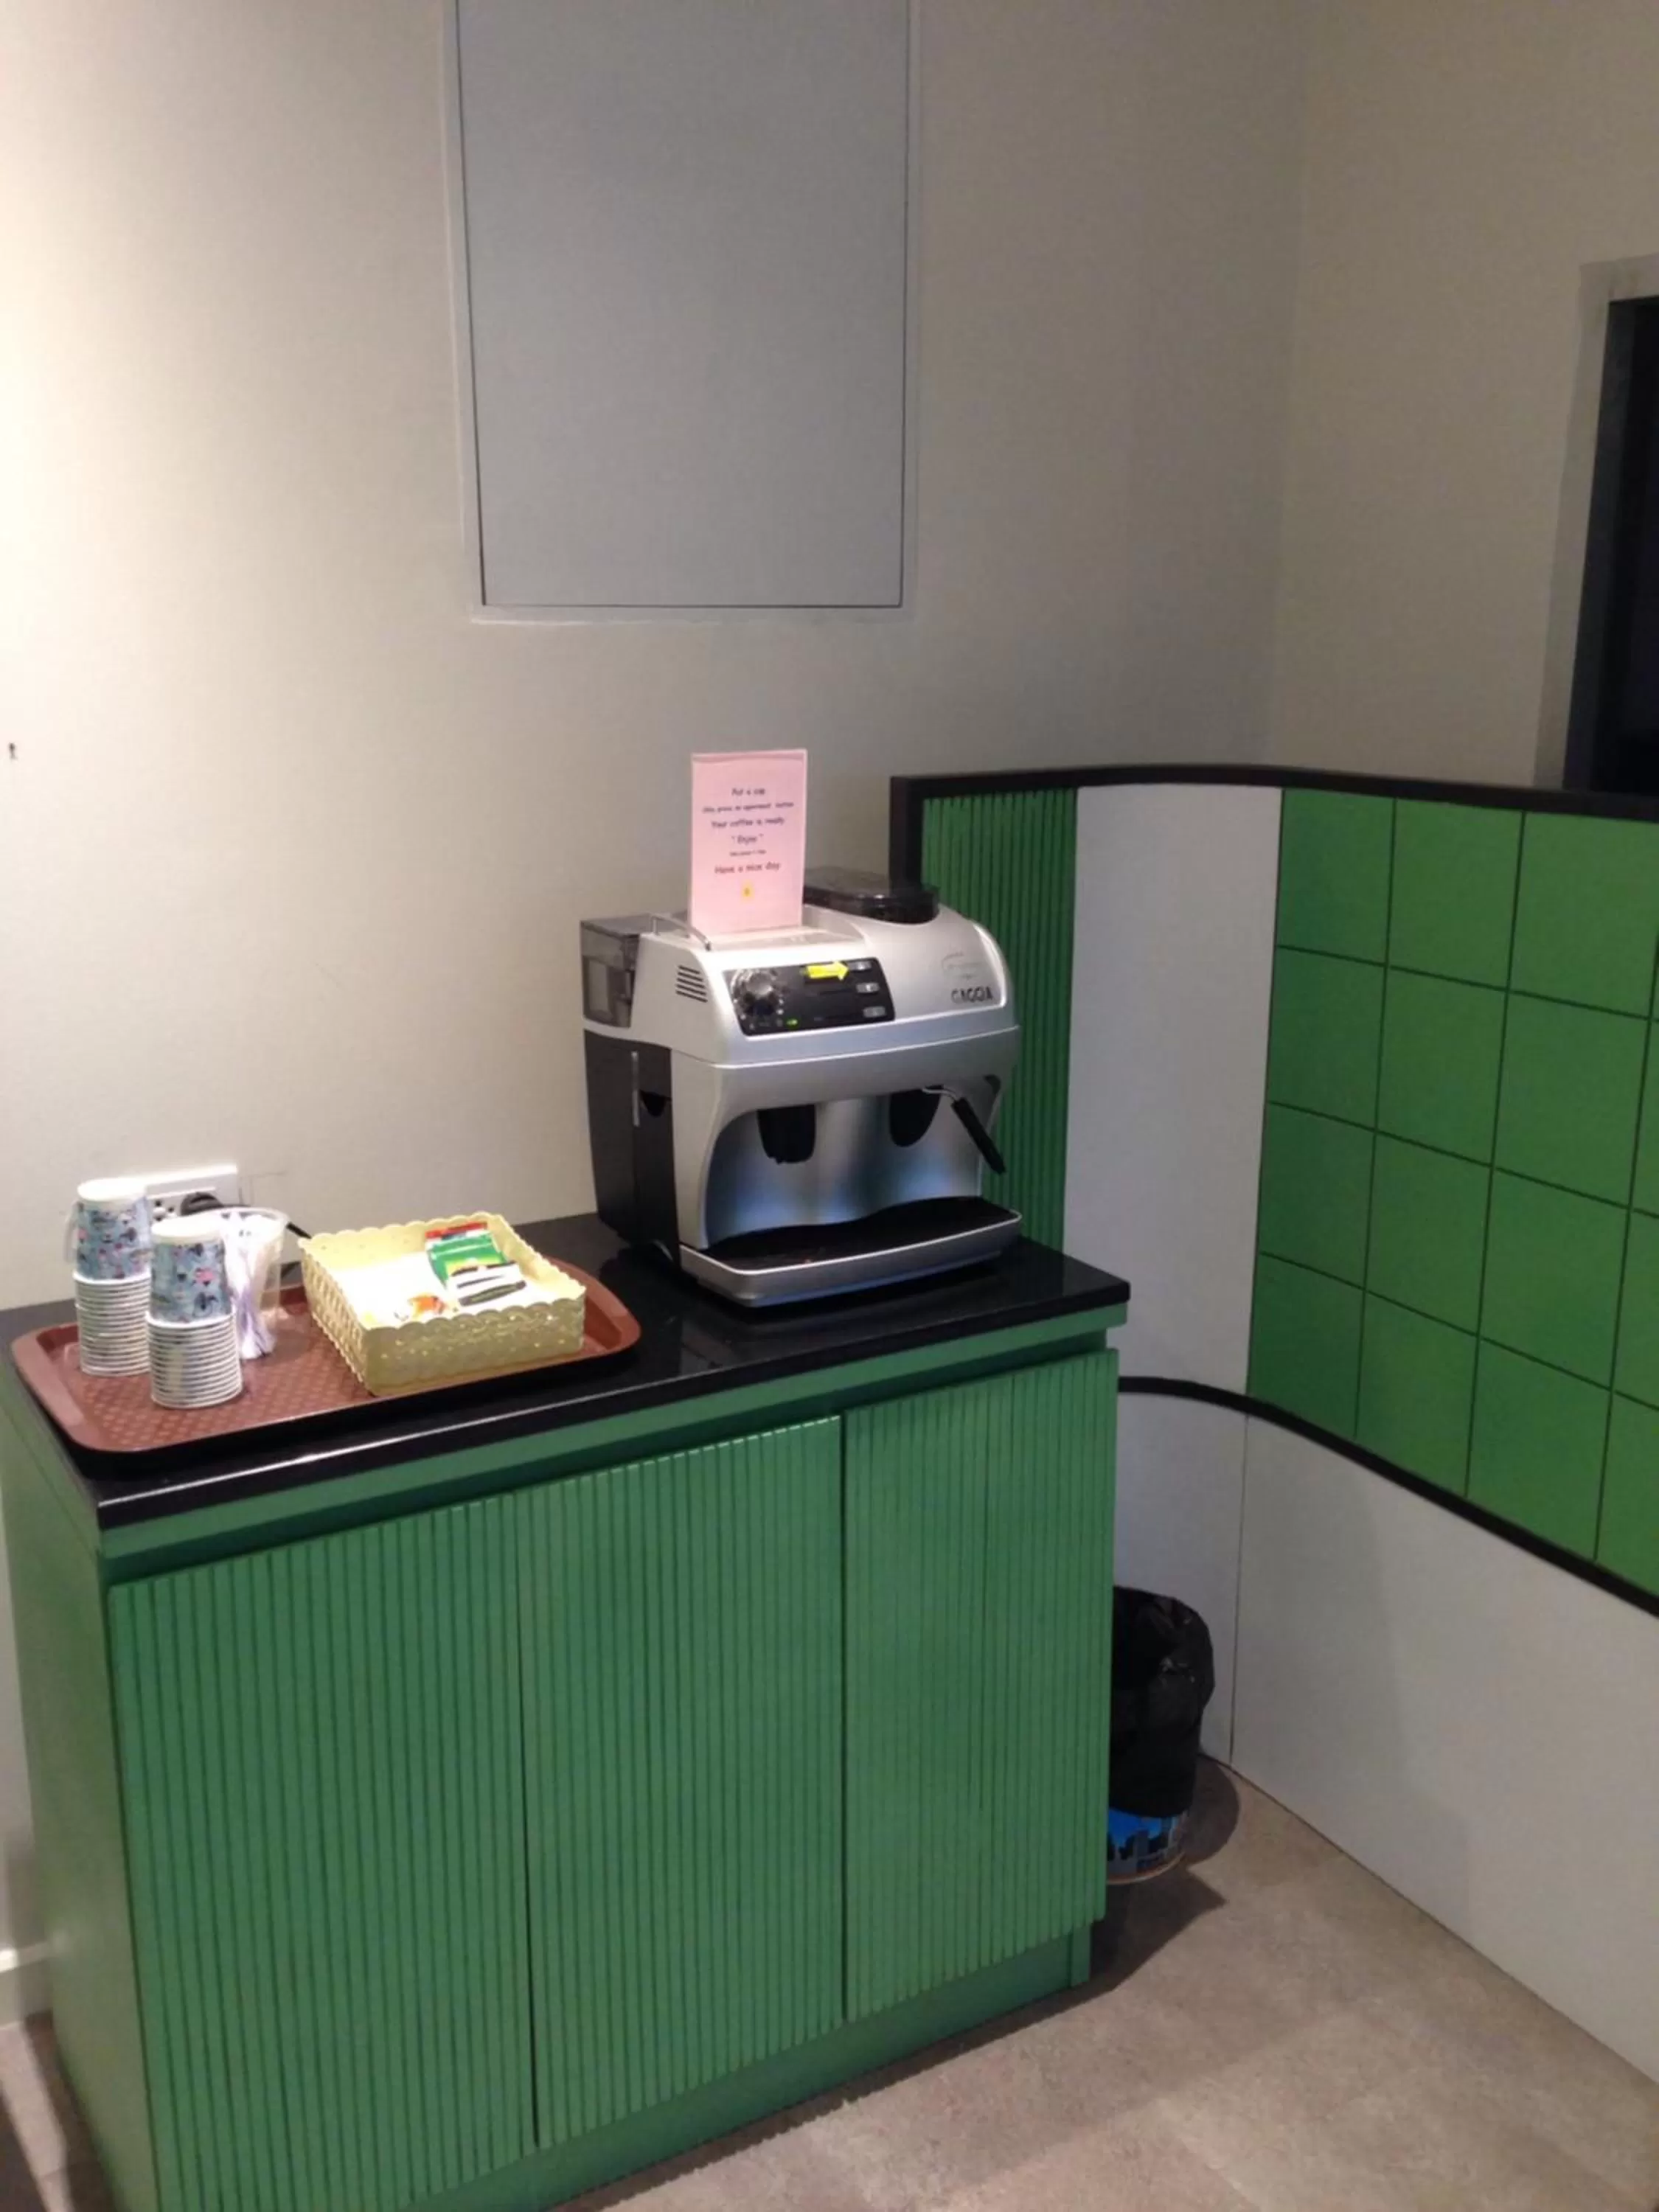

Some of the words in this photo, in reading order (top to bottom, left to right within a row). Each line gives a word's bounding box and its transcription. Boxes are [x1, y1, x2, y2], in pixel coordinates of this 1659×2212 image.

[729, 818, 753, 827] coffee
[714, 864, 735, 874] Have
[745, 863, 762, 872] nice
[765, 860, 781, 872] day
